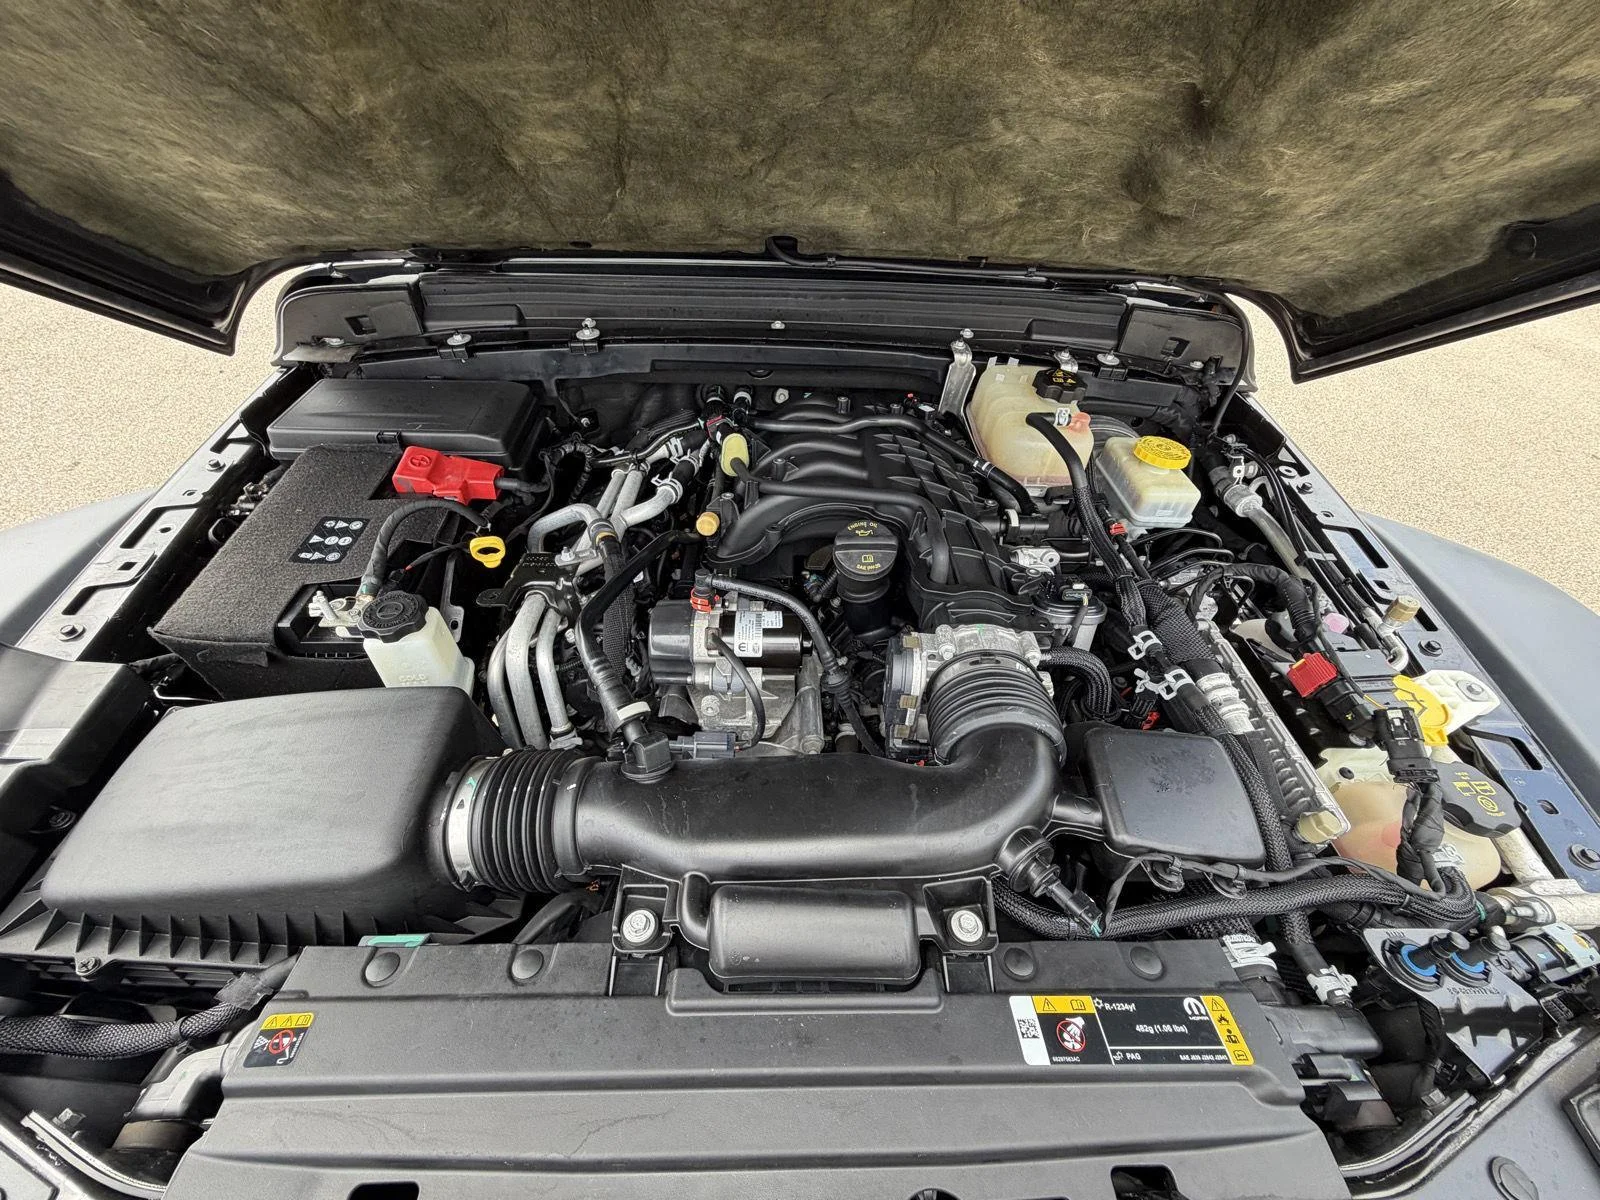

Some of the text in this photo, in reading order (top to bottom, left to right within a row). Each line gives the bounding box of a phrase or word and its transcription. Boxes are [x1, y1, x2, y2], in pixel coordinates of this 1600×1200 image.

[848, 522, 867, 530] ENGINE
[1104, 1002, 1136, 1013] R-1234yf
[1135, 1024, 1155, 1034] 482g
[1173, 1024, 1189, 1034] lbs)
[1125, 1052, 1141, 1061] PAG
